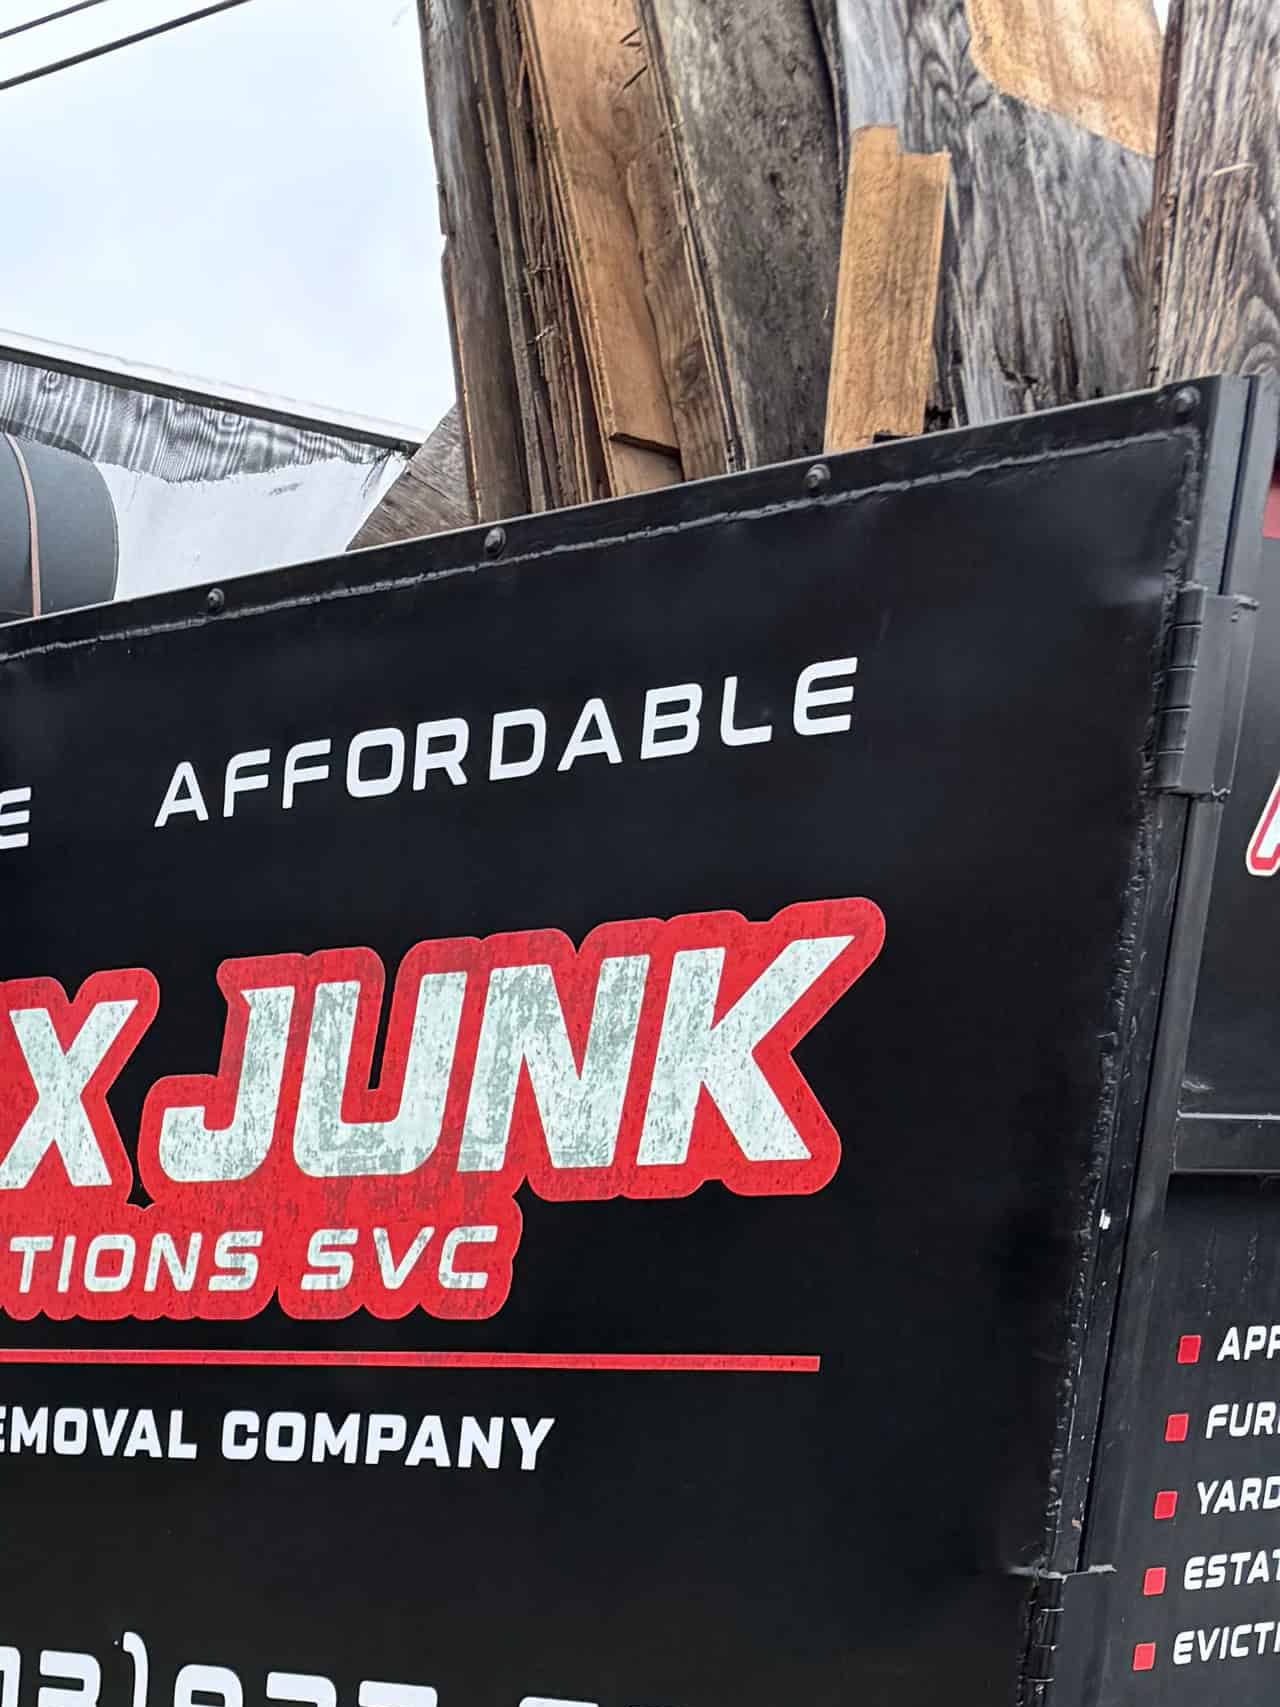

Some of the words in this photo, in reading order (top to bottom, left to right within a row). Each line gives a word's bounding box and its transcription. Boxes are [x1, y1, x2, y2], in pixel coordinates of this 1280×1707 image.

[153, 656, 859, 828] AFFORDABLE
[157, 934, 856, 1184] JUNK
[300, 1225, 499, 1291] SVC
[220, 1410, 556, 1471] COMPANY
